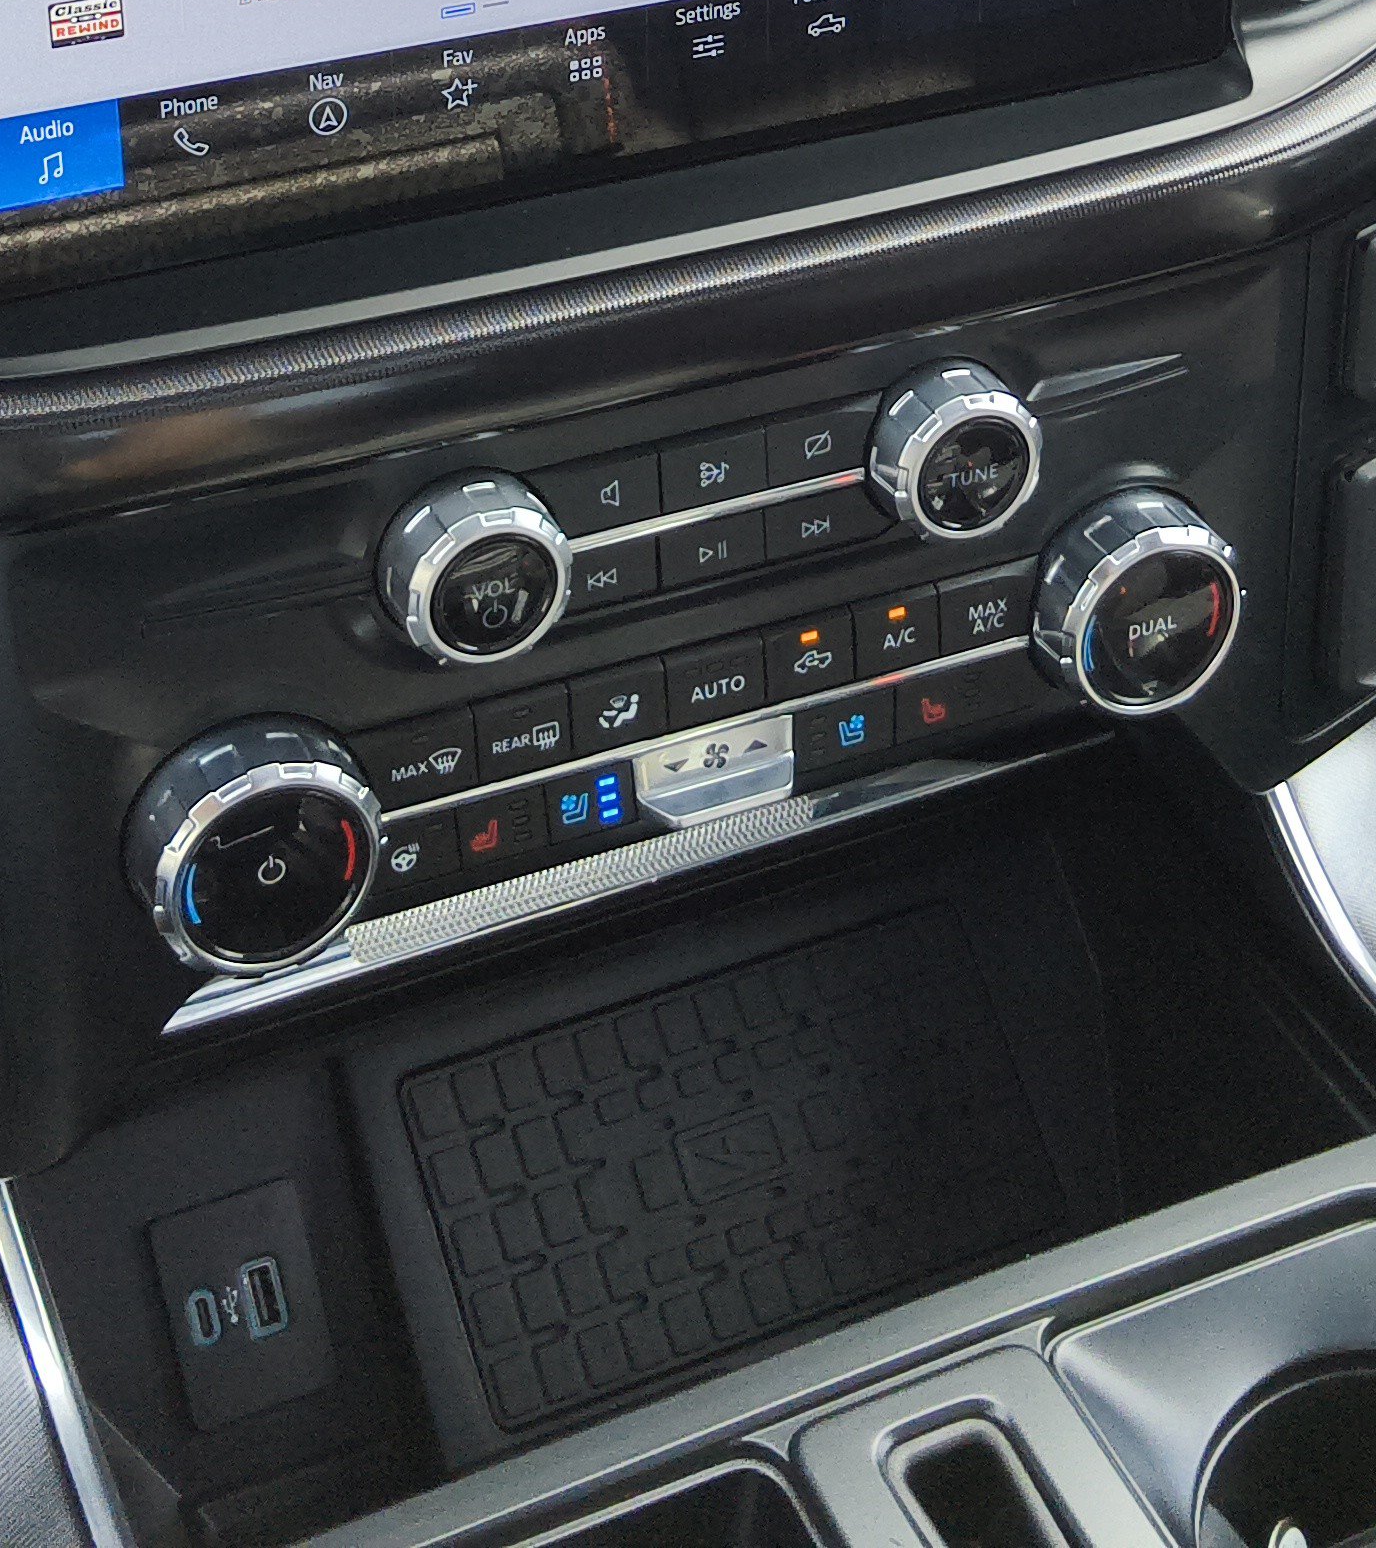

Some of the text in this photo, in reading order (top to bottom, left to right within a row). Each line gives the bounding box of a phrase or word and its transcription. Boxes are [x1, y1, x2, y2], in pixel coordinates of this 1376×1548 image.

[55, 0, 118, 17] Classic
[675, 0, 741, 26] Settings
[56, 18, 120, 38] REWIND
[564, 24, 606, 48] Apps
[441, 47, 474, 69] Fav
[308, 70, 344, 93] Nav
[159, 93, 219, 120] Phone
[19, 119, 75, 144] Audio
[949, 462, 1000, 489] TUNE
[472, 577, 515, 600] VOL
[968, 597, 1008, 621] MAX
[973, 609, 1005, 635] A/C
[1129, 615, 1178, 641] DUAL
[883, 626, 916, 650] A/C
[690, 673, 746, 703] AUTO
[492, 733, 532, 754] REAR
[391, 759, 429, 782] MAX
